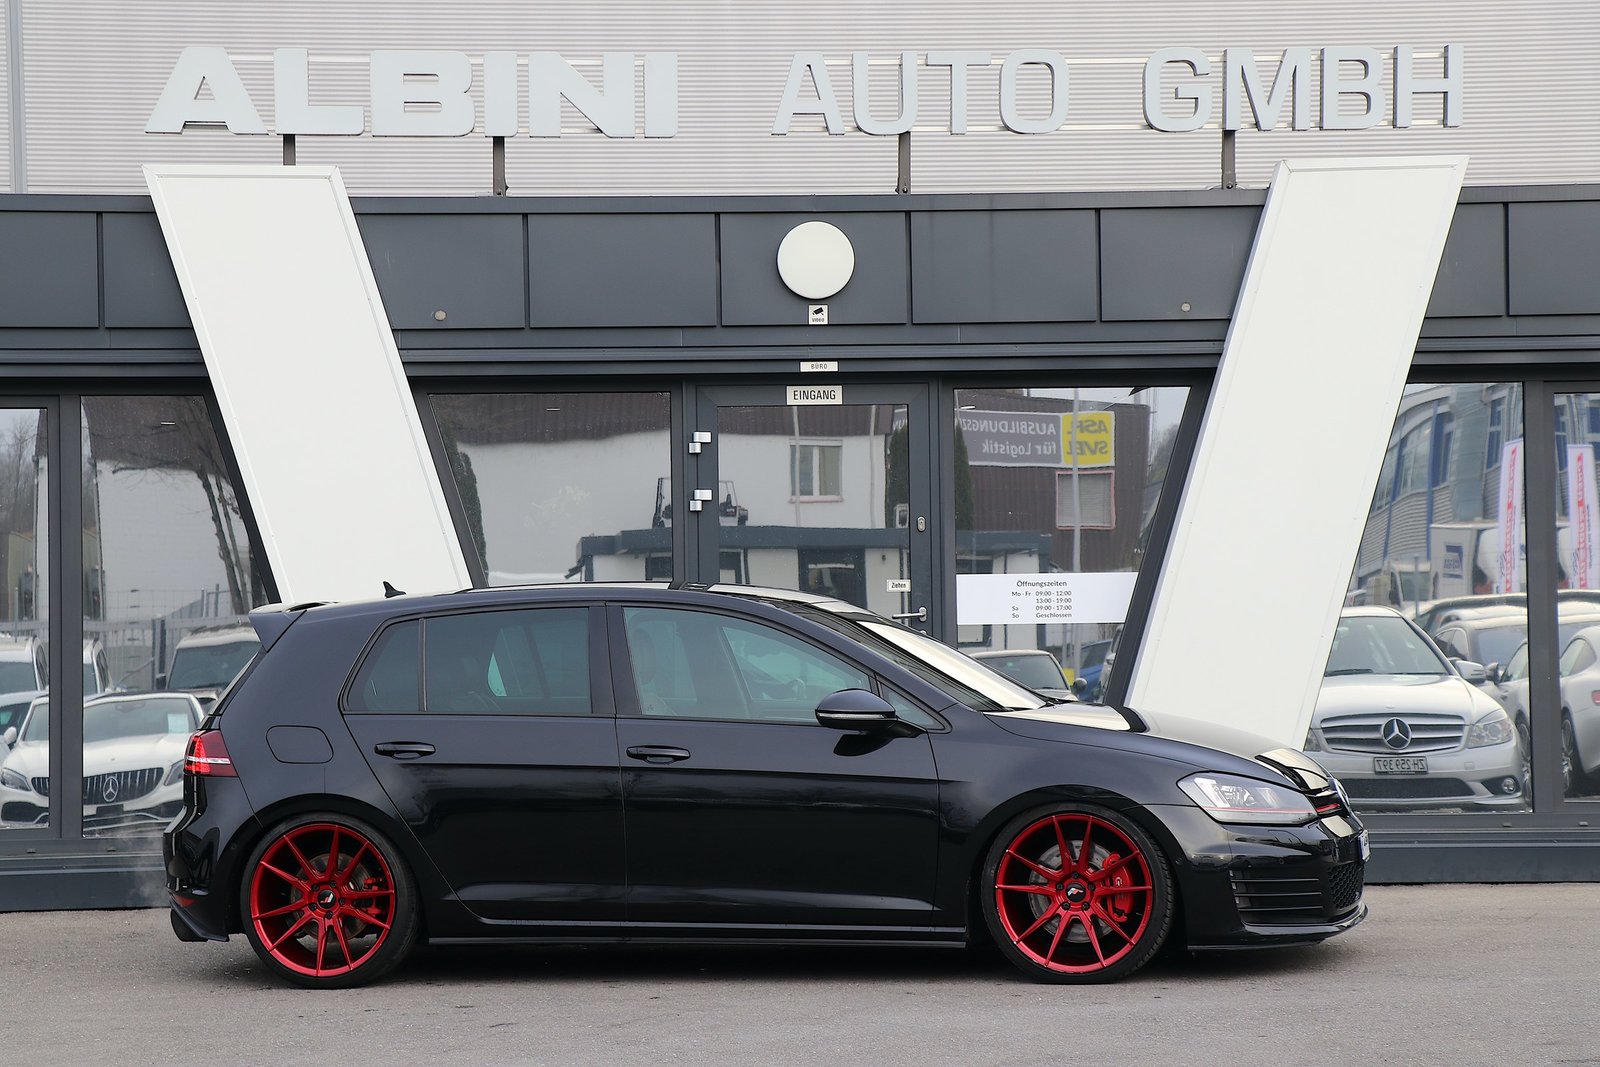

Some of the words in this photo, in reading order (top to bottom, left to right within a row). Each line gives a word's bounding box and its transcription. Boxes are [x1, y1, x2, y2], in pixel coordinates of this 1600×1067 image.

[145, 46, 678, 138] ALBINI
[771, 48, 1070, 136] AUTO
[1142, 43, 1464, 133] GMBH
[793, 389, 836, 401] EINGANG
[1016, 580, 1068, 588] Öffnungszeiten
